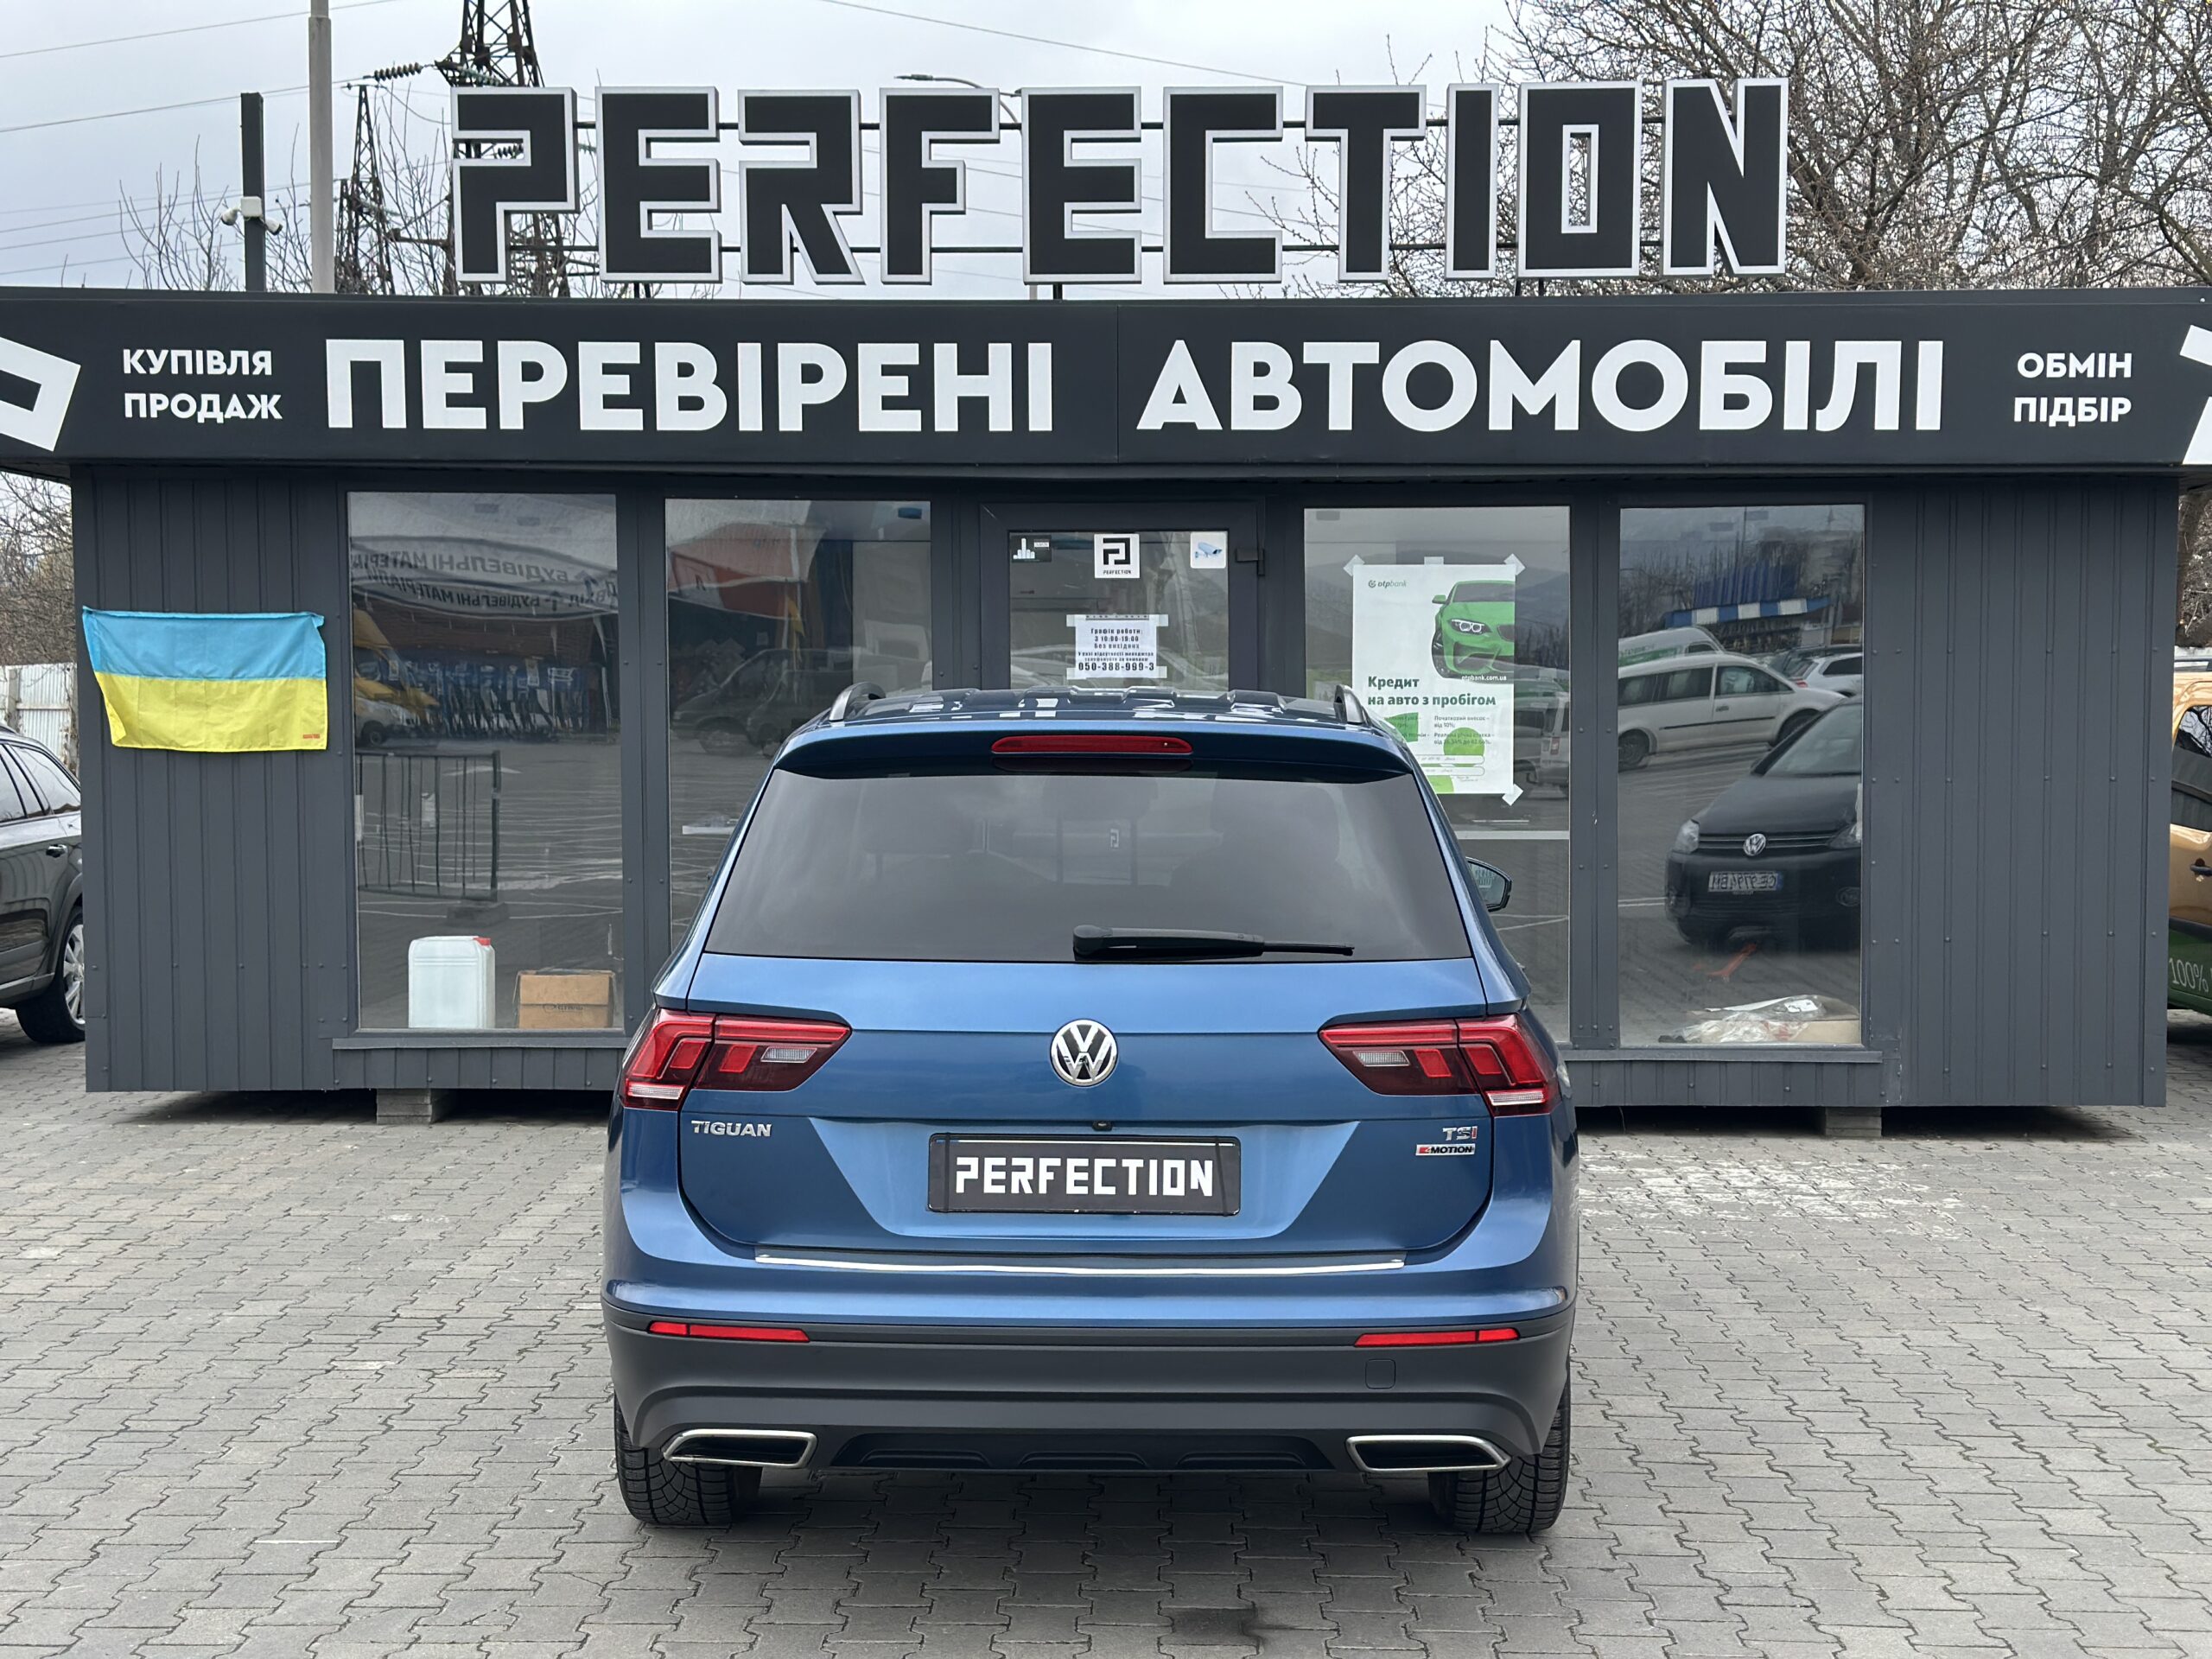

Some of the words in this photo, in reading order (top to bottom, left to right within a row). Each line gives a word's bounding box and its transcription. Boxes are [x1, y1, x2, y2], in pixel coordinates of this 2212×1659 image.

[451, 78, 1789, 284] PERFECTION
[123, 348, 272, 376] КУПІВЛЯ
[2017, 352, 2133, 378] ОБМІН
[326, 339, 1052, 432] ПЕРЕВІРЕНІ
[1136, 339, 1944, 432] АВТОМОБІЛІ
[124, 392, 283, 423] ПРОДАЖ
[2013, 397, 2132, 428] ПІДБІР
[1378, 580, 1408, 588] otpbank
[1078, 662, 1154, 671] 050-388-999-3
[1368, 676, 1420, 690] Кредит
[1368, 696, 1384, 705] на
[1388, 696, 1420, 705] авто
[1422, 696, 1429, 705] з
[1433, 693, 1496, 708] пробігом
[2169, 957, 2209, 993] 100%
[691, 1121, 772, 1137] TIGUAN
[1442, 1125, 1478, 1141] TSI
[956, 1156, 1213, 1197] PERFECTION
